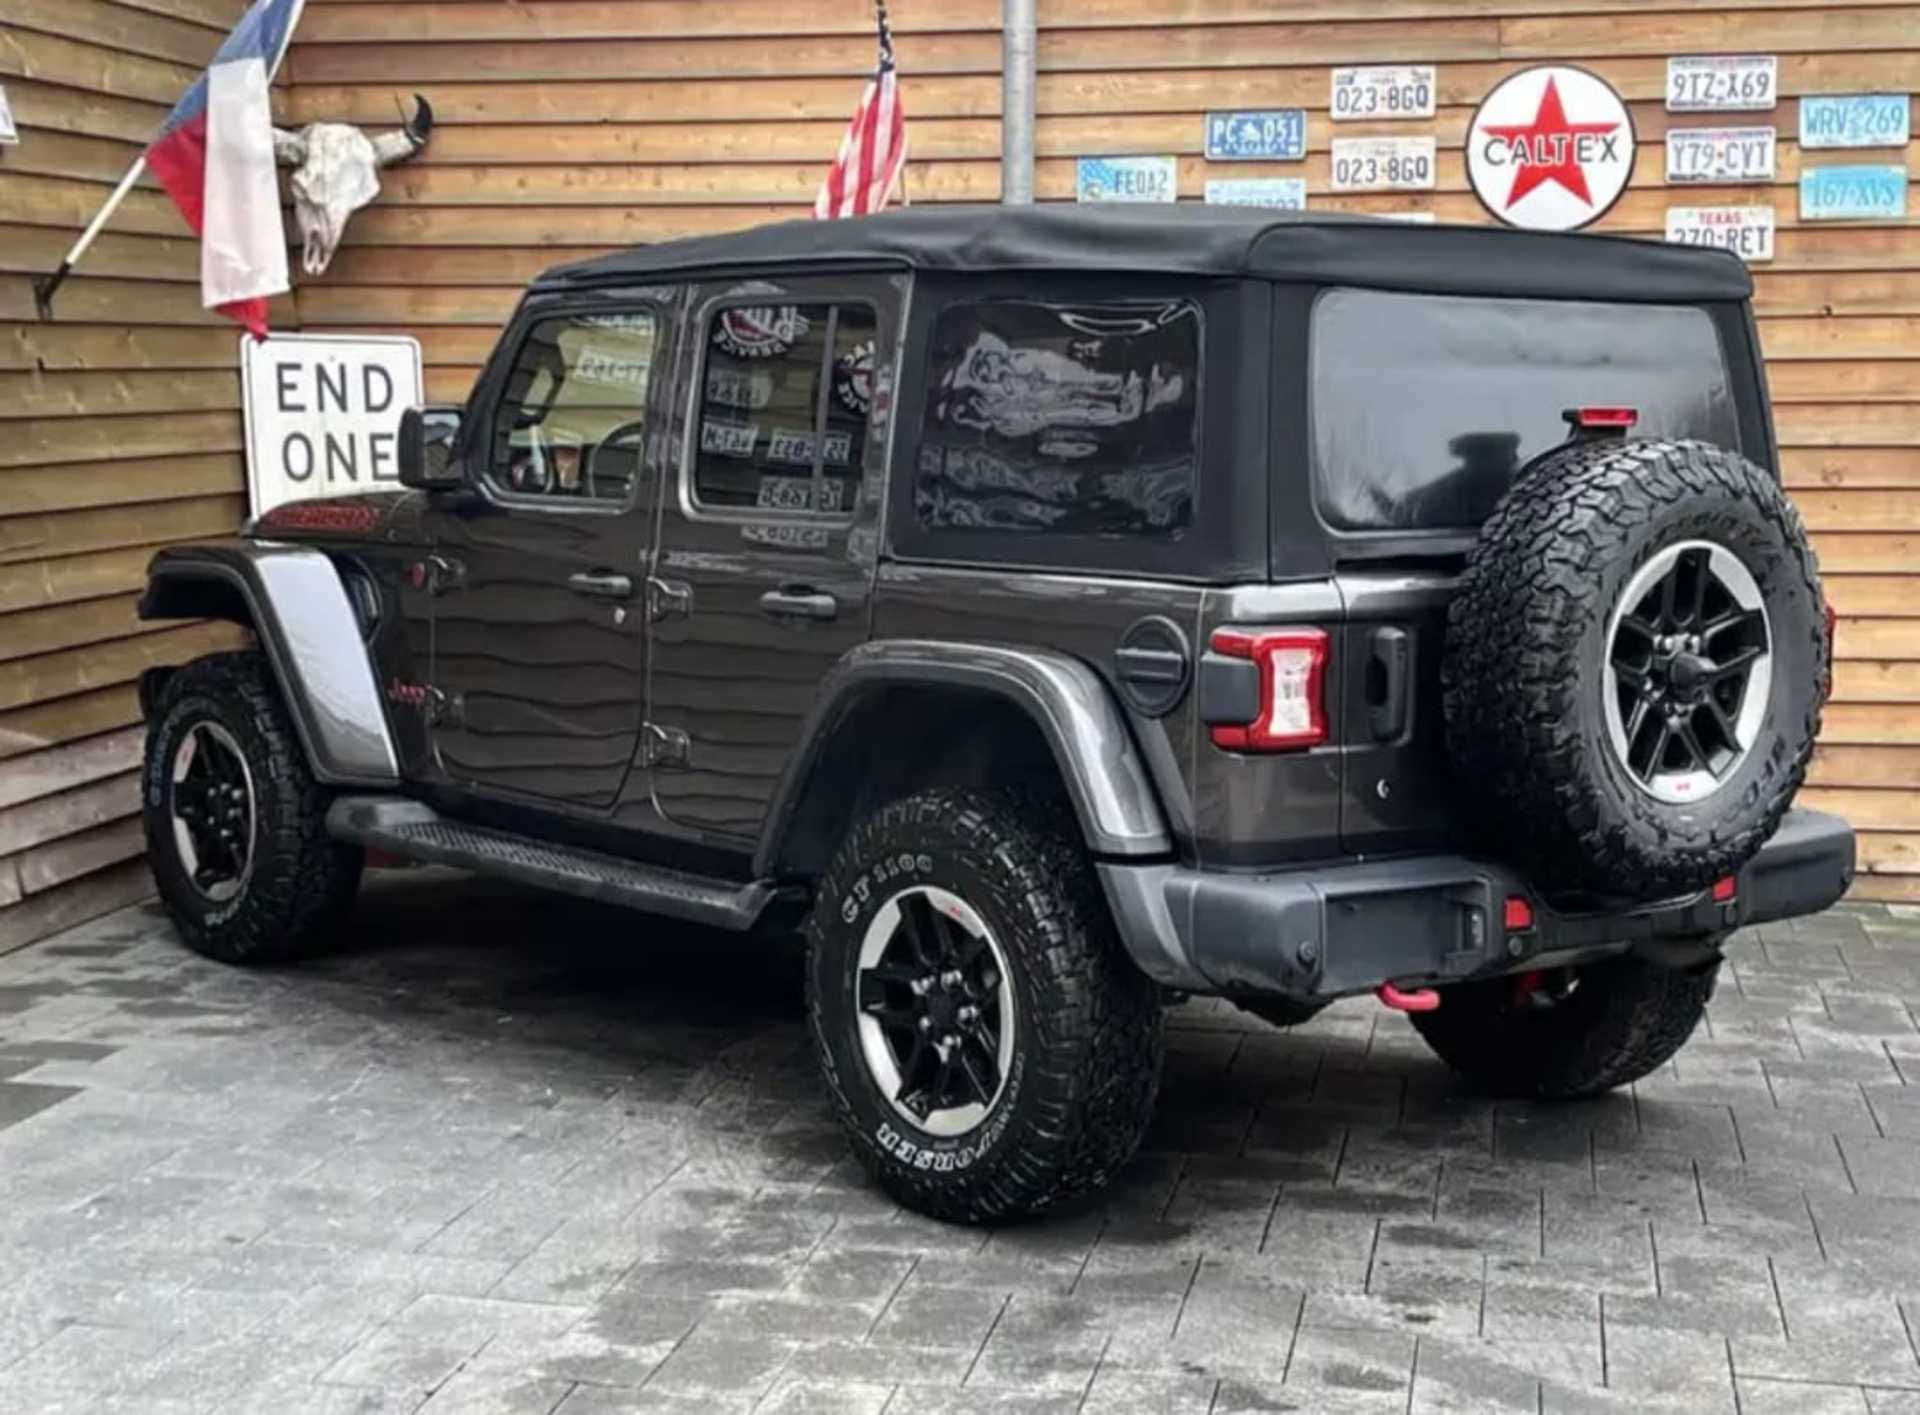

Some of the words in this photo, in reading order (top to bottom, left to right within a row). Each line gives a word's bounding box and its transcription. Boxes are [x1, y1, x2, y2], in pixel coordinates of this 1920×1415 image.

[1483, 134, 1618, 167] CALTEX
[1699, 211, 1742, 225] TEXAS
[276, 362, 394, 413] END
[282, 431, 400, 483] ONE
